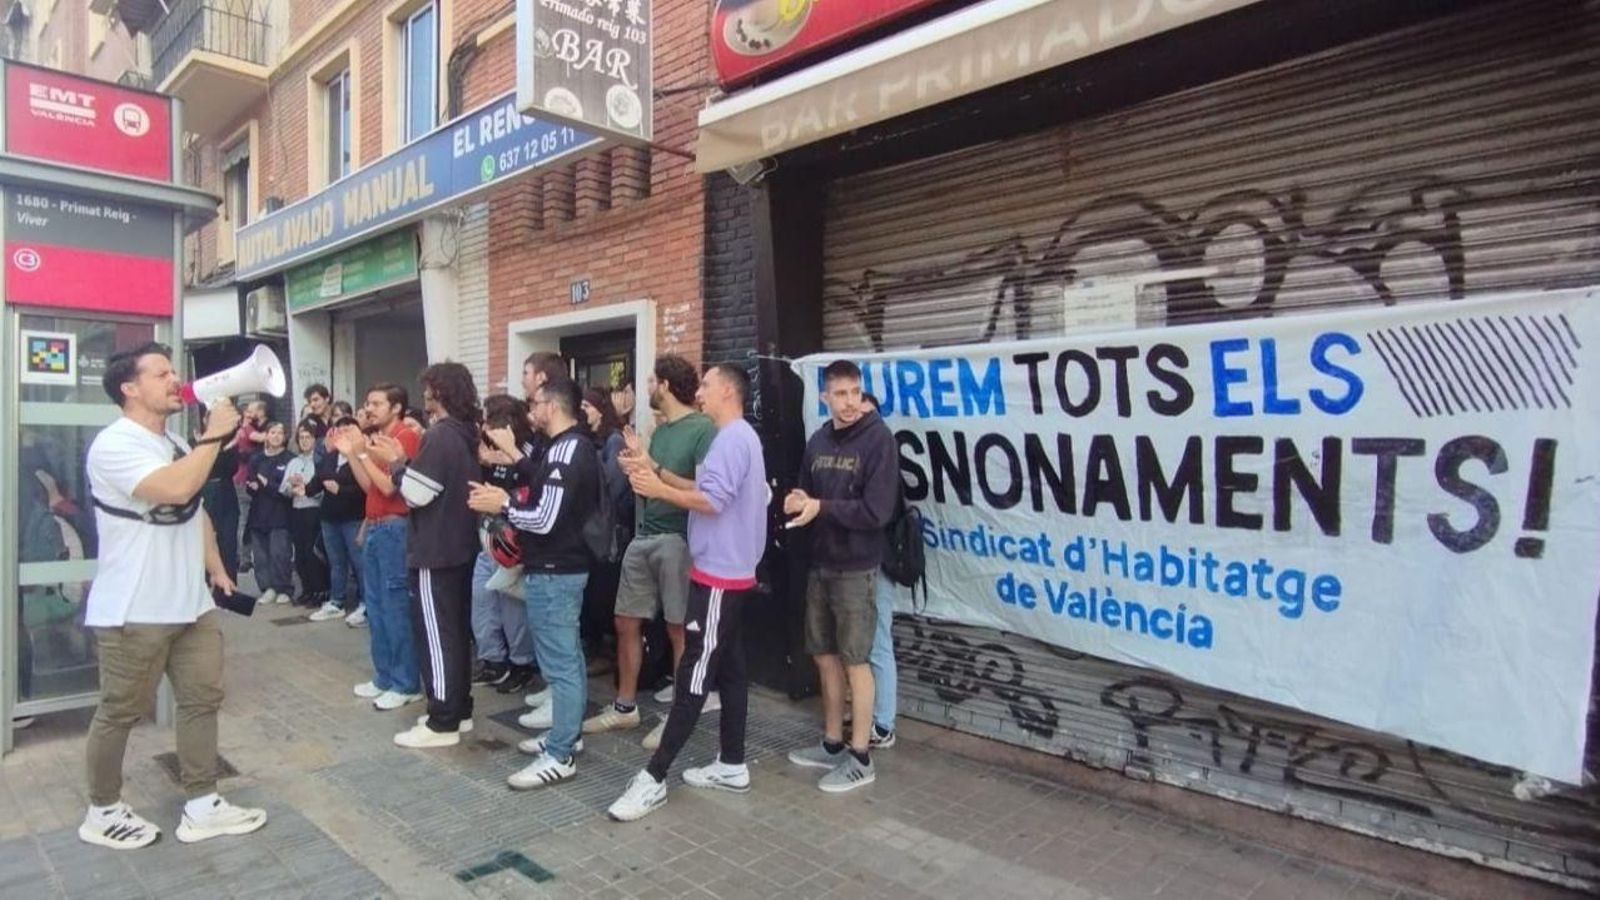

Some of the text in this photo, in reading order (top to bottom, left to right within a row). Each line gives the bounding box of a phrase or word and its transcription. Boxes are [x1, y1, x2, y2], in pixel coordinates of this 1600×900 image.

[597, 18, 621, 39] reig
[624, 26, 647, 45] 103
[552, 28, 638, 90] BAR
[29, 82, 96, 108] EMT
[453, 125, 476, 159] EL
[760, 90, 859, 150] BAR
[499, 146, 521, 173] 637
[523, 138, 539, 161] 12
[540, 129, 558, 154] 05
[16, 193, 49, 210] 1680
[60, 200, 102, 218] Primat
[103, 207, 130, 225] Reig
[16, 211, 48, 227] Viver
[237, 201, 335, 270] AUTOLAVADO
[343, 154, 436, 230] MANUAL
[570, 280, 590, 304] 103
[817, 357, 1007, 419] UREM
[1012, 342, 1196, 418] TOTS
[1209, 331, 1365, 417] ELS
[894, 429, 1559, 560] SNONAMENTS!
[921, 516, 1056, 568] Sindicat
[995, 571, 1214, 650] de València
